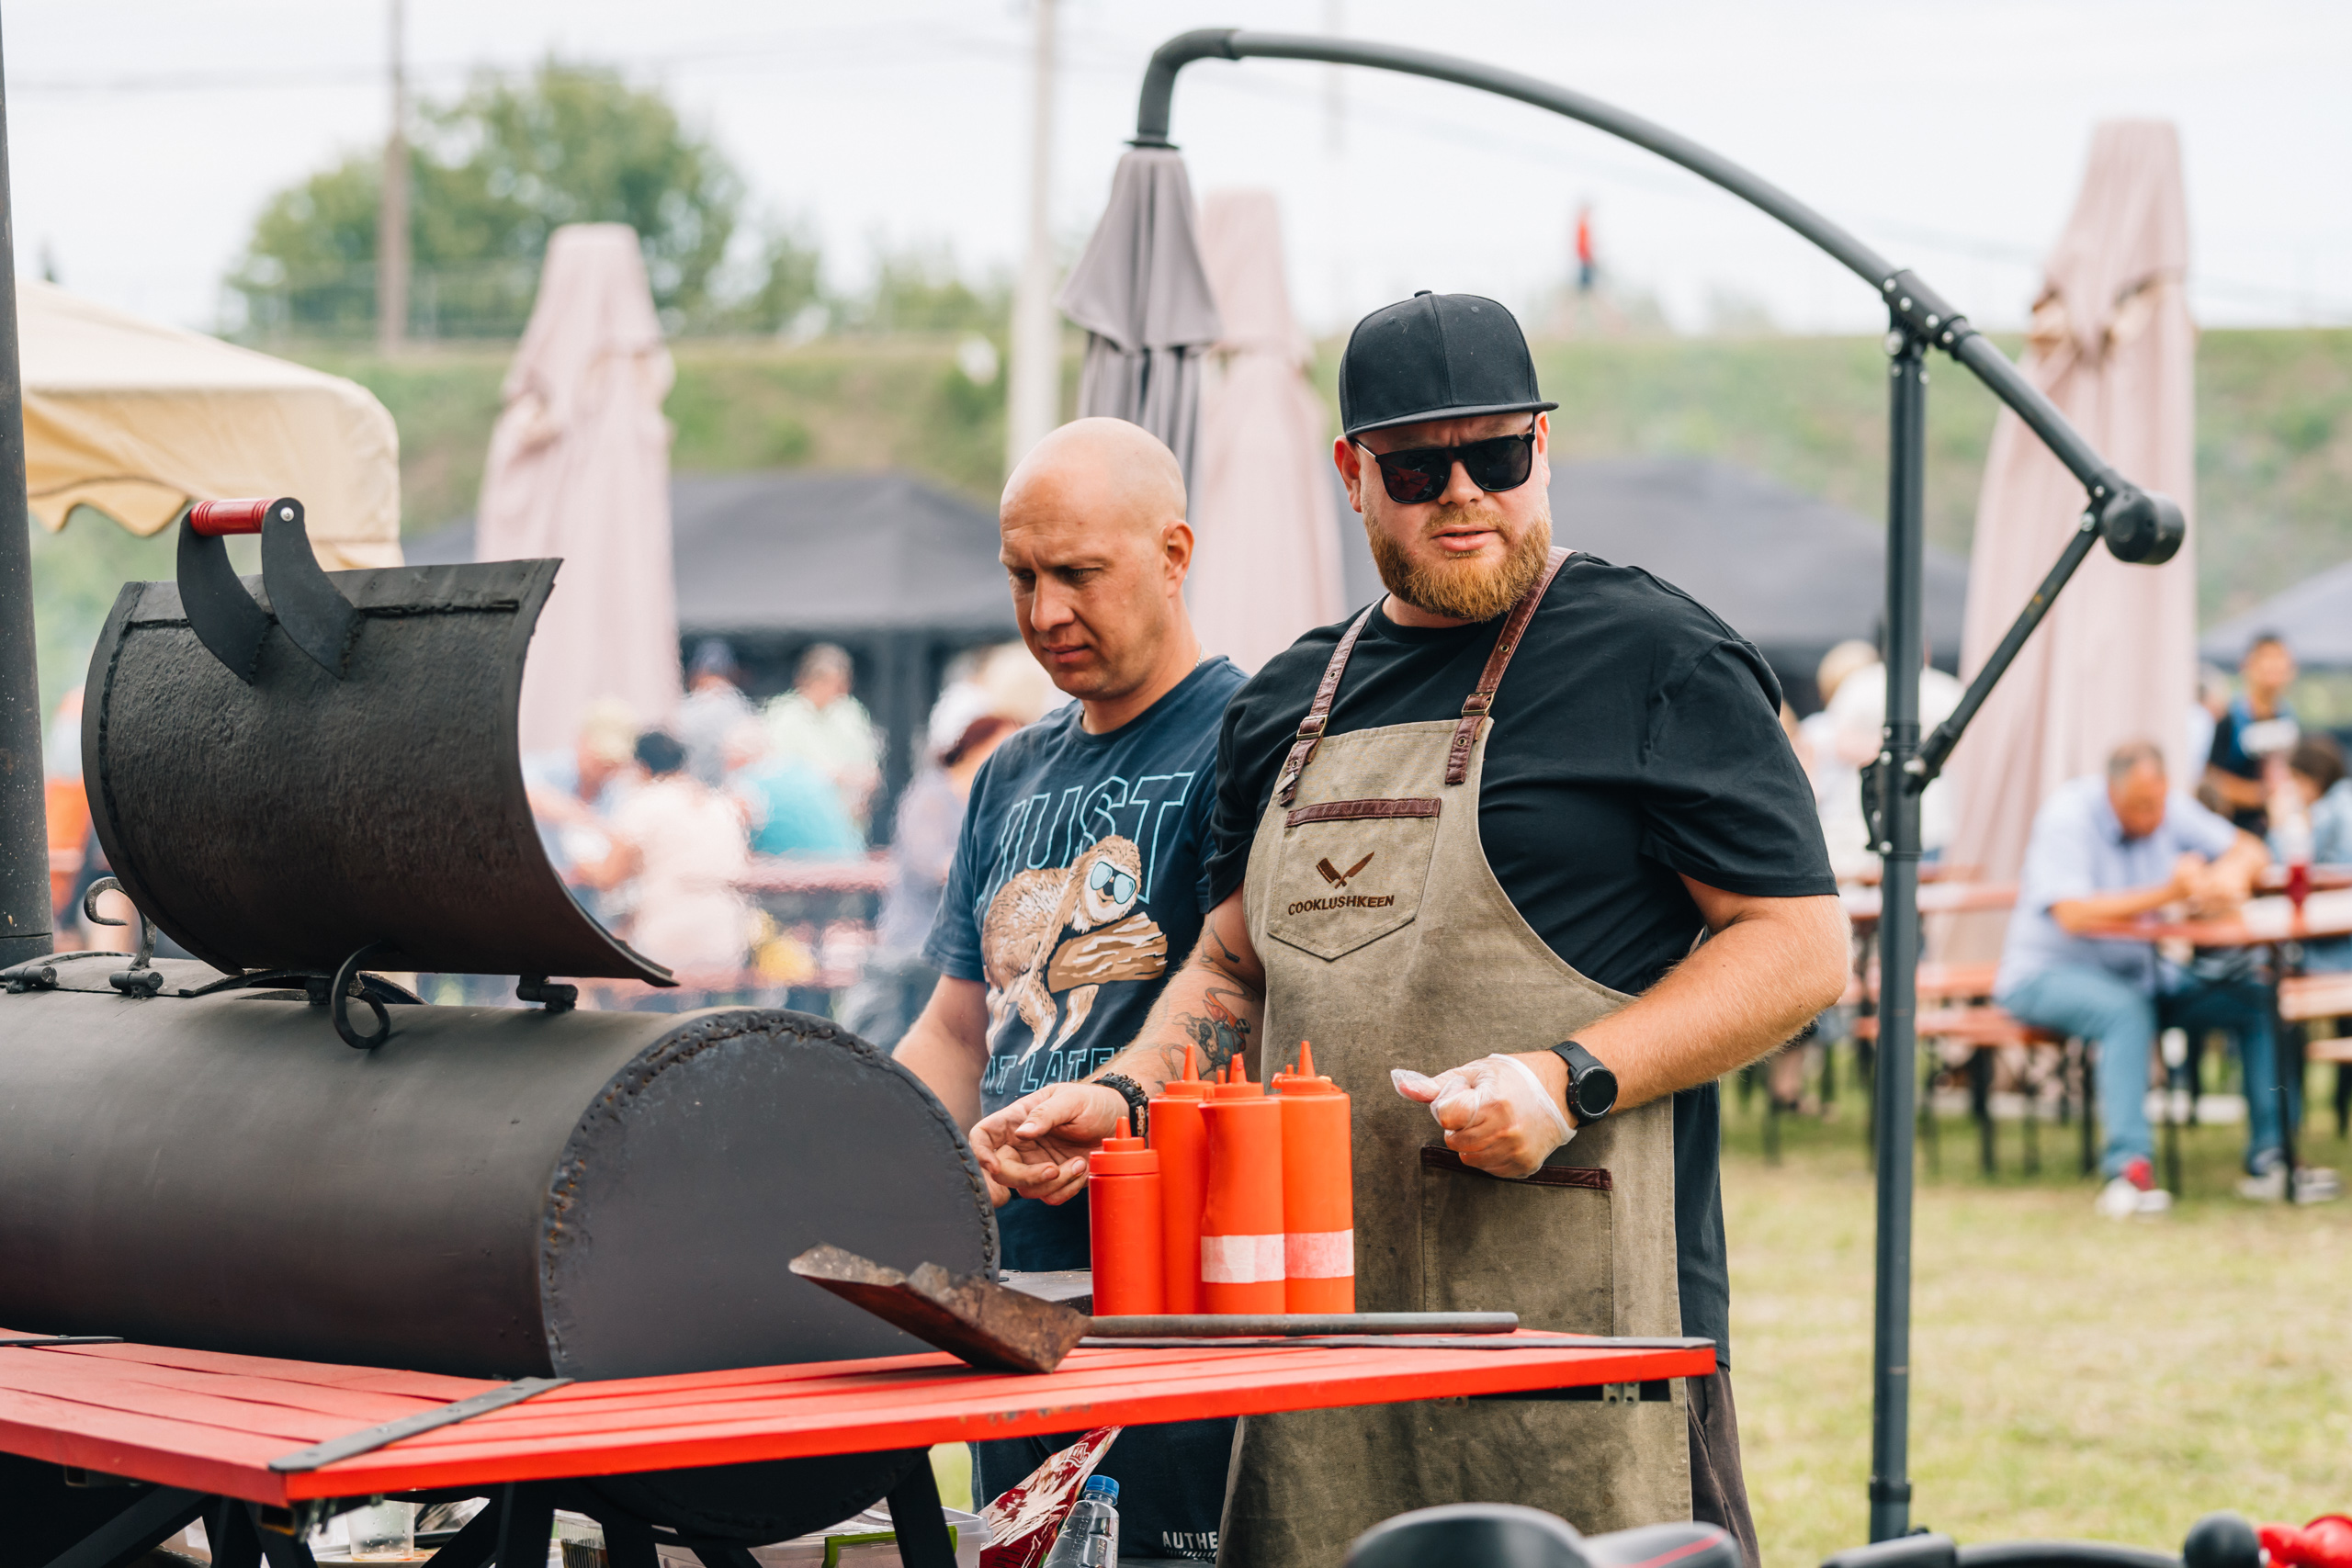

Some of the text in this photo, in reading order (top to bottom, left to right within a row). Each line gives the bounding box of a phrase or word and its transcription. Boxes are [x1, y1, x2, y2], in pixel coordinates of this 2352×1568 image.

[977, 772, 1196, 904] JUST
[1288, 895, 1395, 916] COOKLUSHKEEN
[1019, 1046, 1129, 1093] LATE
